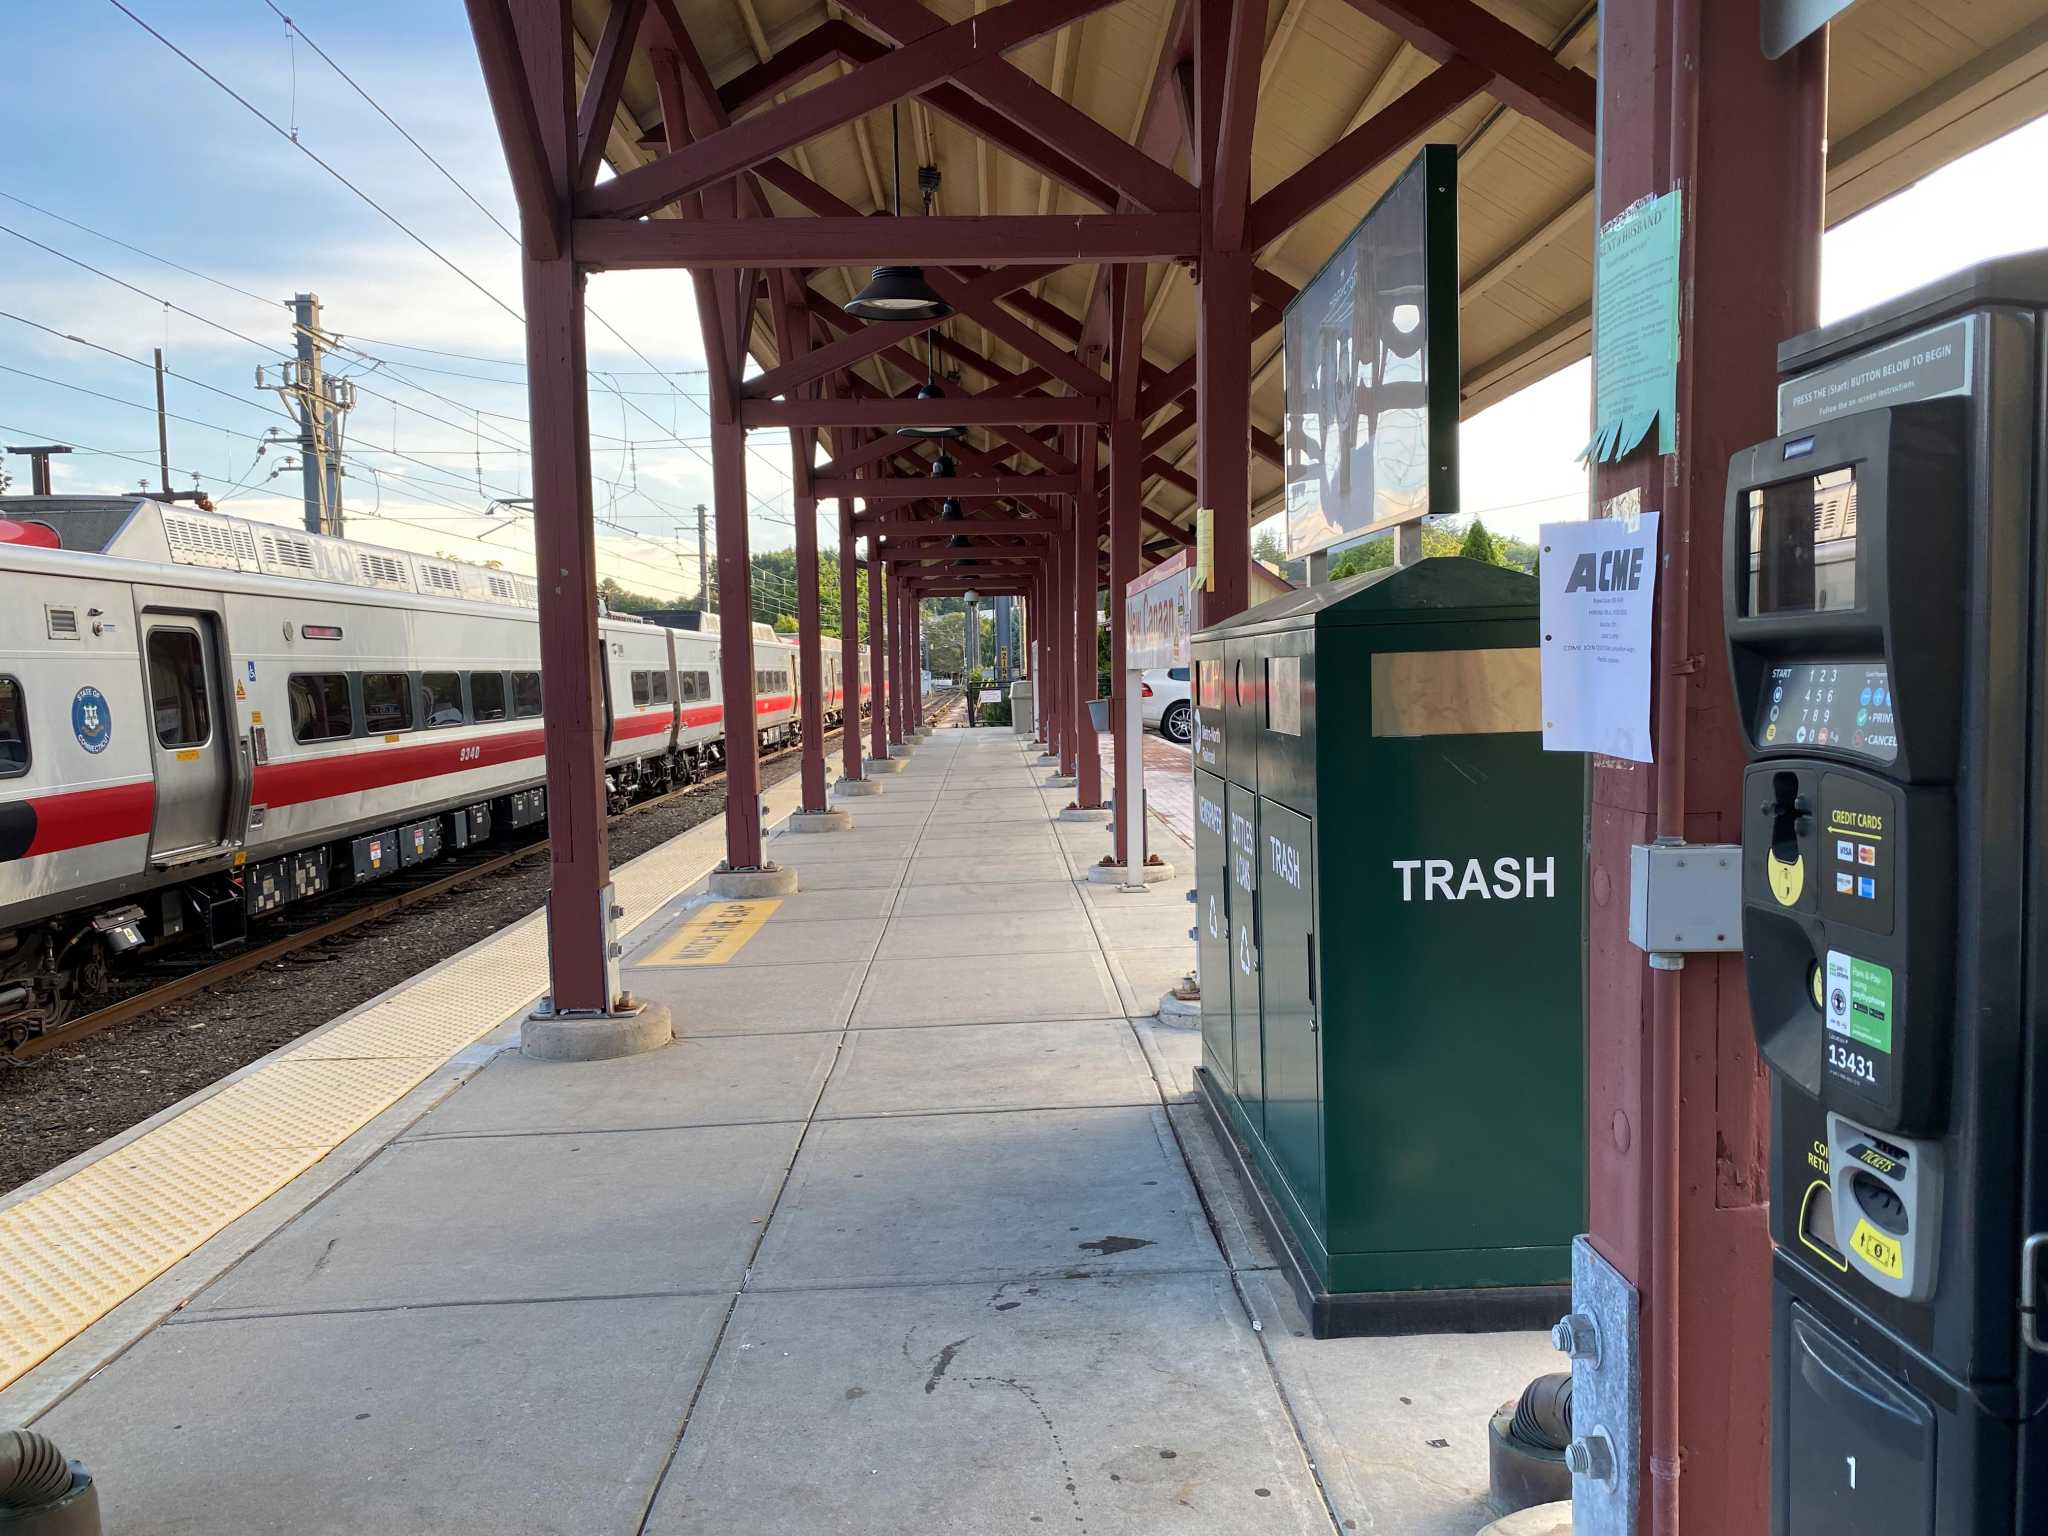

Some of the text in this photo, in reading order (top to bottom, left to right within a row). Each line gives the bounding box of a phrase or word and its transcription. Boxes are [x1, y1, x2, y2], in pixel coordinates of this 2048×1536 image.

[1792, 390, 1815, 408] PRESS
[1814, 387, 1828, 400] THE
[1850, 368, 1882, 389] BUTTON
[1882, 359, 1911, 377] BELOW
[1912, 353, 1924, 367] TO
[1925, 343, 1953, 362] BEGIN
[1565, 548, 1645, 593] ACME
[1143, 593, 1175, 641] Canaan
[1771, 668, 1792, 679] START
[1871, 713, 1894, 724] PRINT
[1867, 734, 1899, 747] CANCEL
[459, 746, 480, 761] 9340
[1832, 809, 1882, 830] CREDIT CARDS
[1231, 811, 1253, 856] BOTTLES
[1270, 835, 1301, 890] TRASH
[1839, 846, 1852, 856] VISA
[1392, 856, 1555, 901] TRASH
[1828, 1043, 1876, 1083] 13431
[1814, 1140, 1829, 1157] COI
[1808, 1153, 1829, 1174] RETU
[1860, 1150, 1895, 1173] TICKETS
[1847, 1456, 1856, 1490] 1
